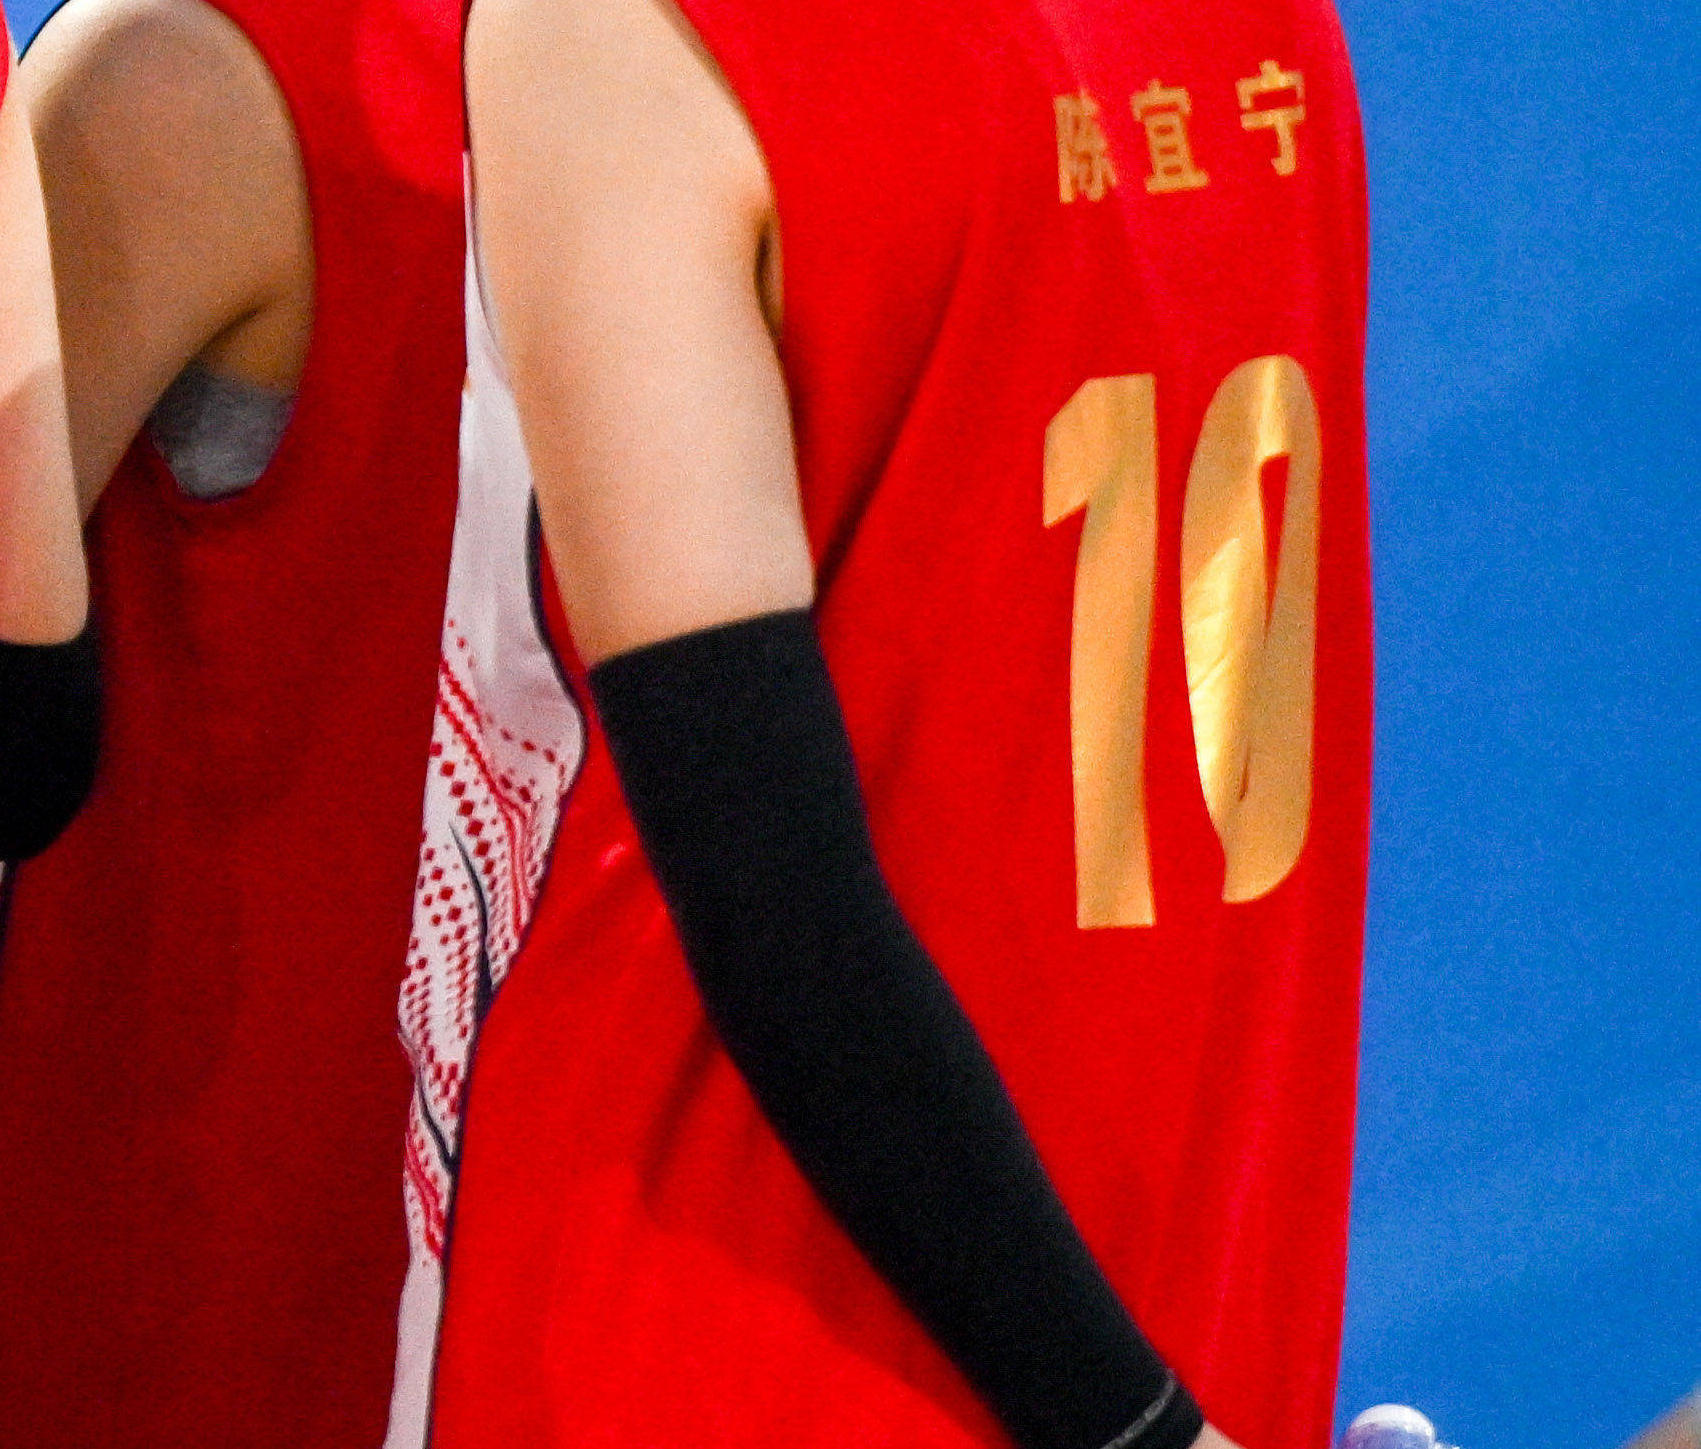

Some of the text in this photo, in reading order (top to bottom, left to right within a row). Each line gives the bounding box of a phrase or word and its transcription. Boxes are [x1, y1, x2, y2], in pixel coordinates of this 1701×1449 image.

[1052, 59, 1307, 204] 陈宜宁
[1042, 354, 1322, 930] 10
